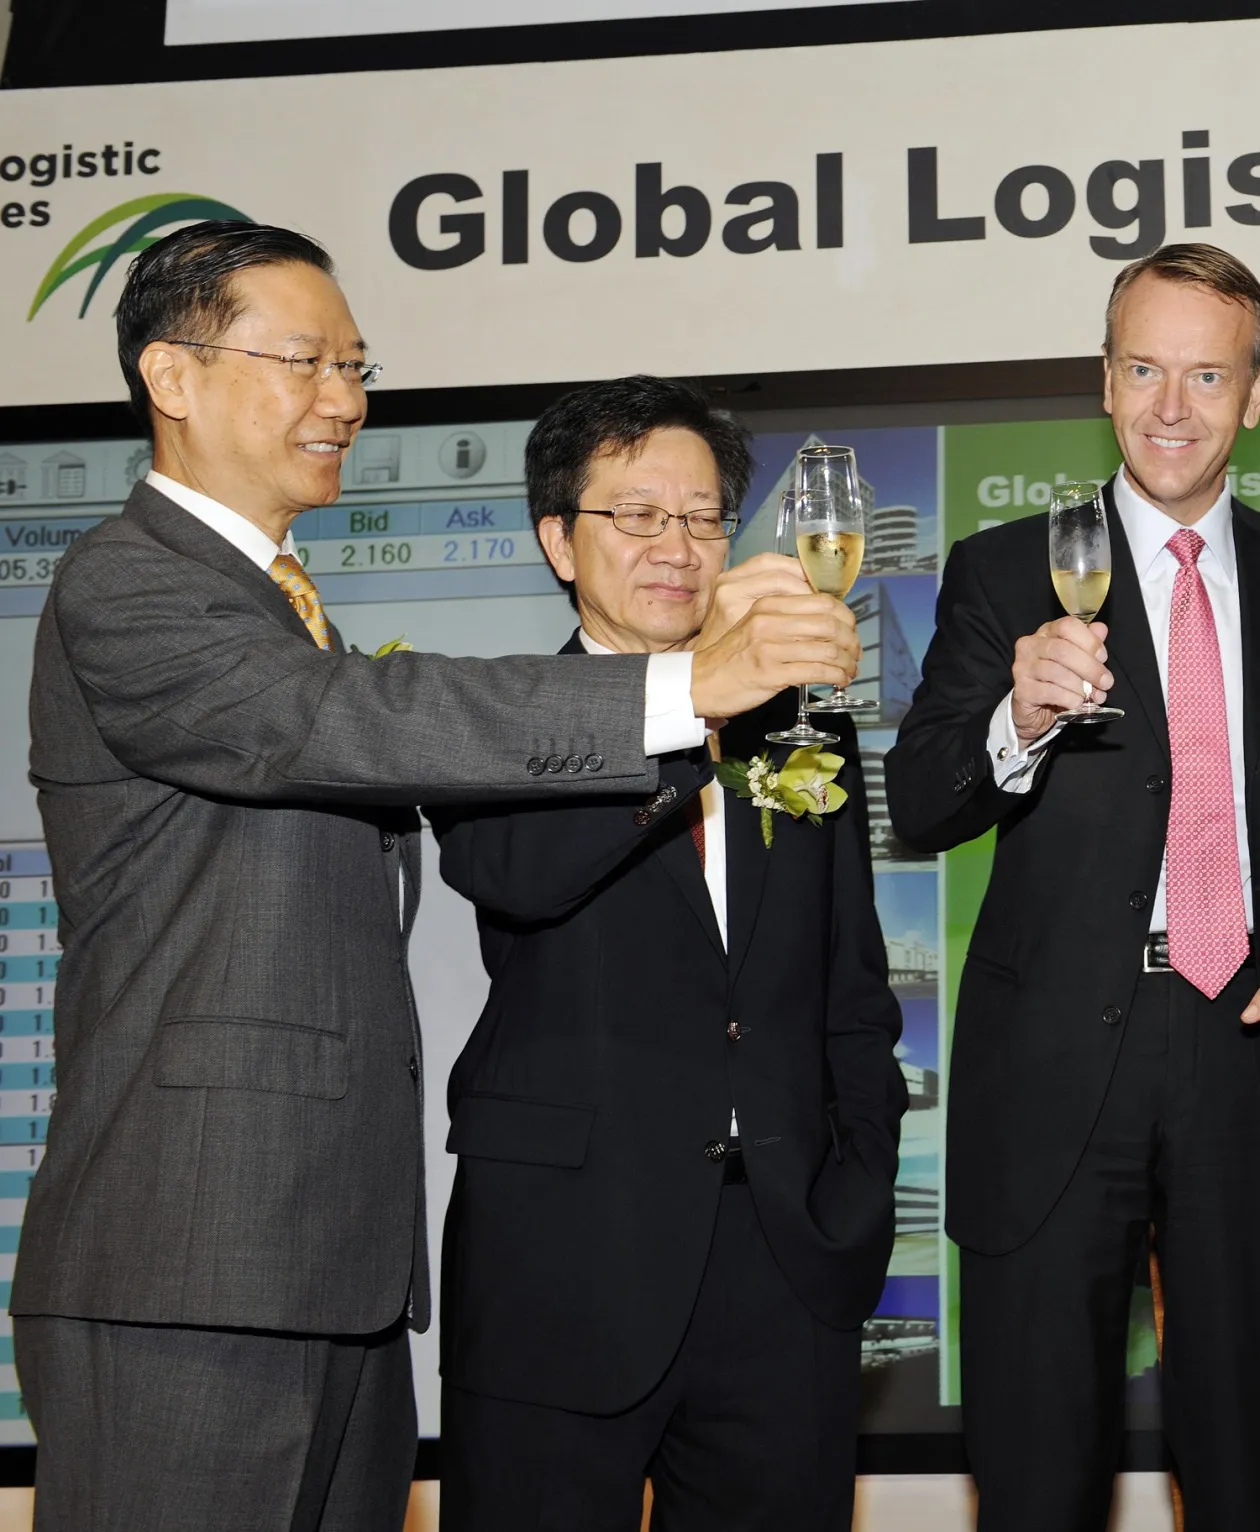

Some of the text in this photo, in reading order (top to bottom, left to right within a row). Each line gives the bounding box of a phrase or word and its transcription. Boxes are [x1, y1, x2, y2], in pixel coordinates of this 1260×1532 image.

[388, 153, 844, 271] Global
[5, 506, 495, 547] Volum Bid Ask
[341, 543, 412, 567] 2.160
[444, 538, 514, 562] 2.170
